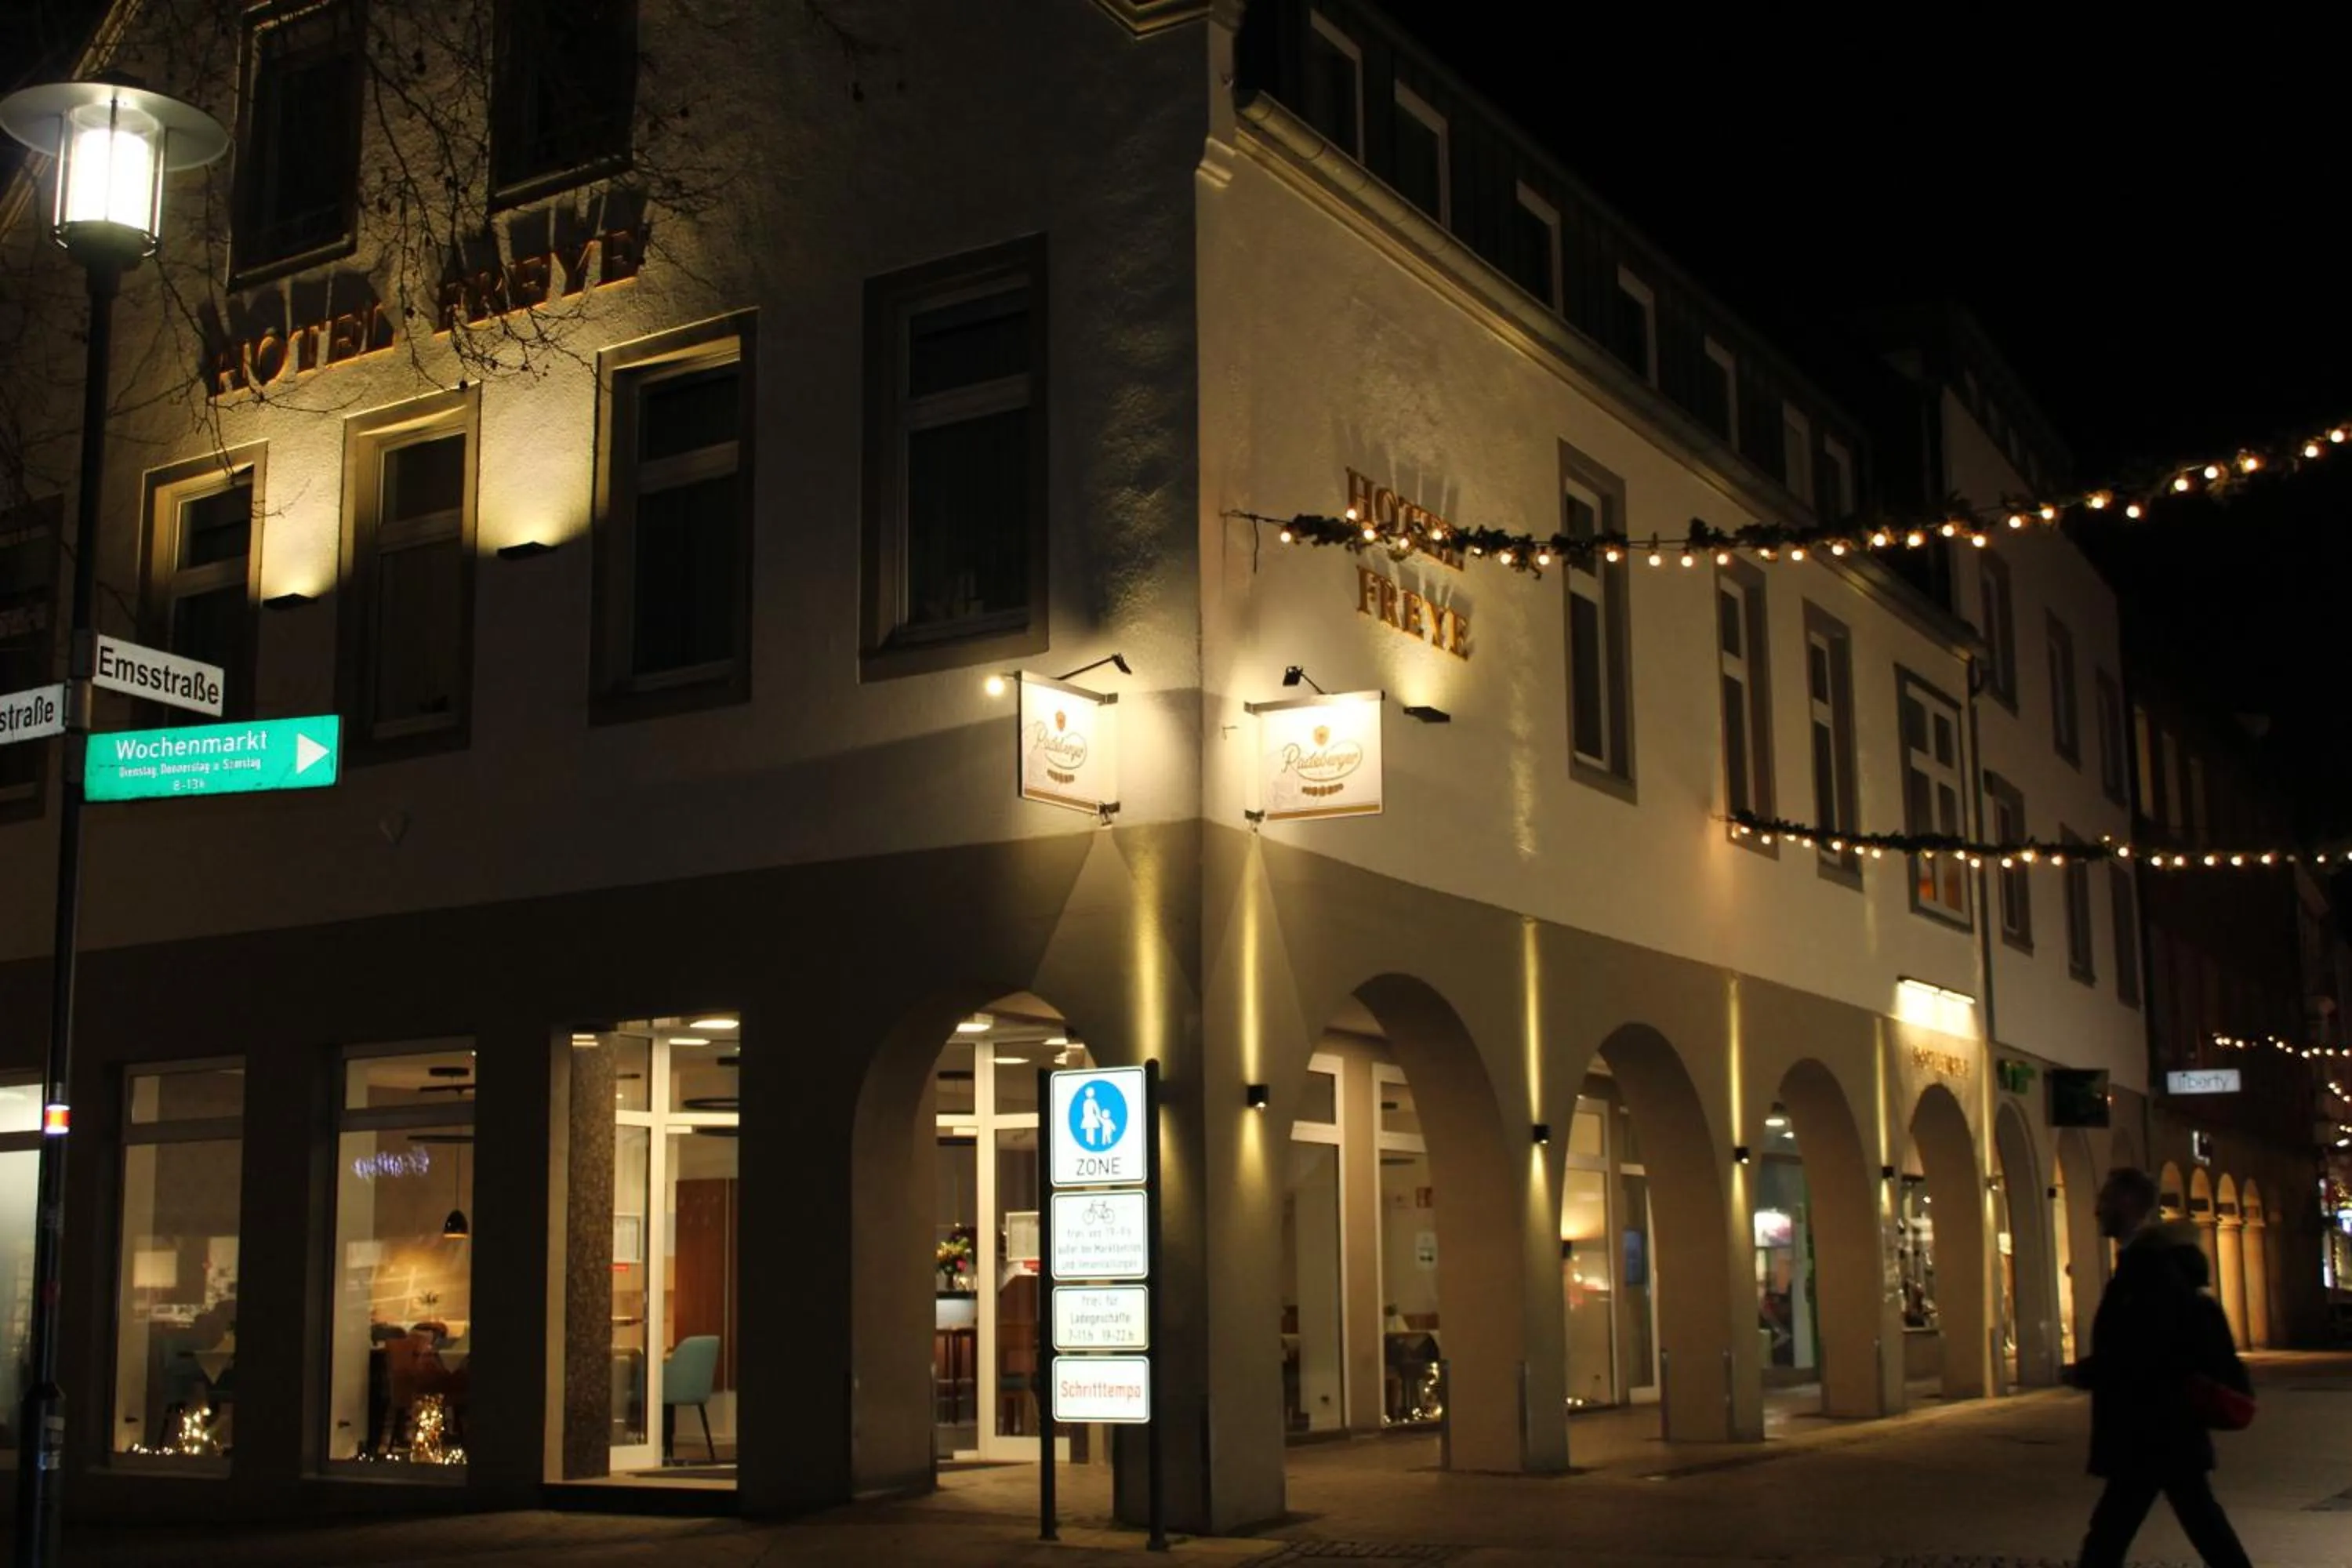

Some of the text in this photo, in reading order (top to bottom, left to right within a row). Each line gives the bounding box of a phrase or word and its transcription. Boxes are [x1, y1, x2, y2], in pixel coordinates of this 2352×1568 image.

[209, 302, 394, 399] HOTEL
[1357, 565, 1468, 661] FREYE
[98, 645, 220, 705] Emsstraße
[115, 730, 268, 760] Wochenmarkt
[1076, 1156, 1123, 1176] ZONE
[1060, 1380, 1142, 1403] Schritttempo
